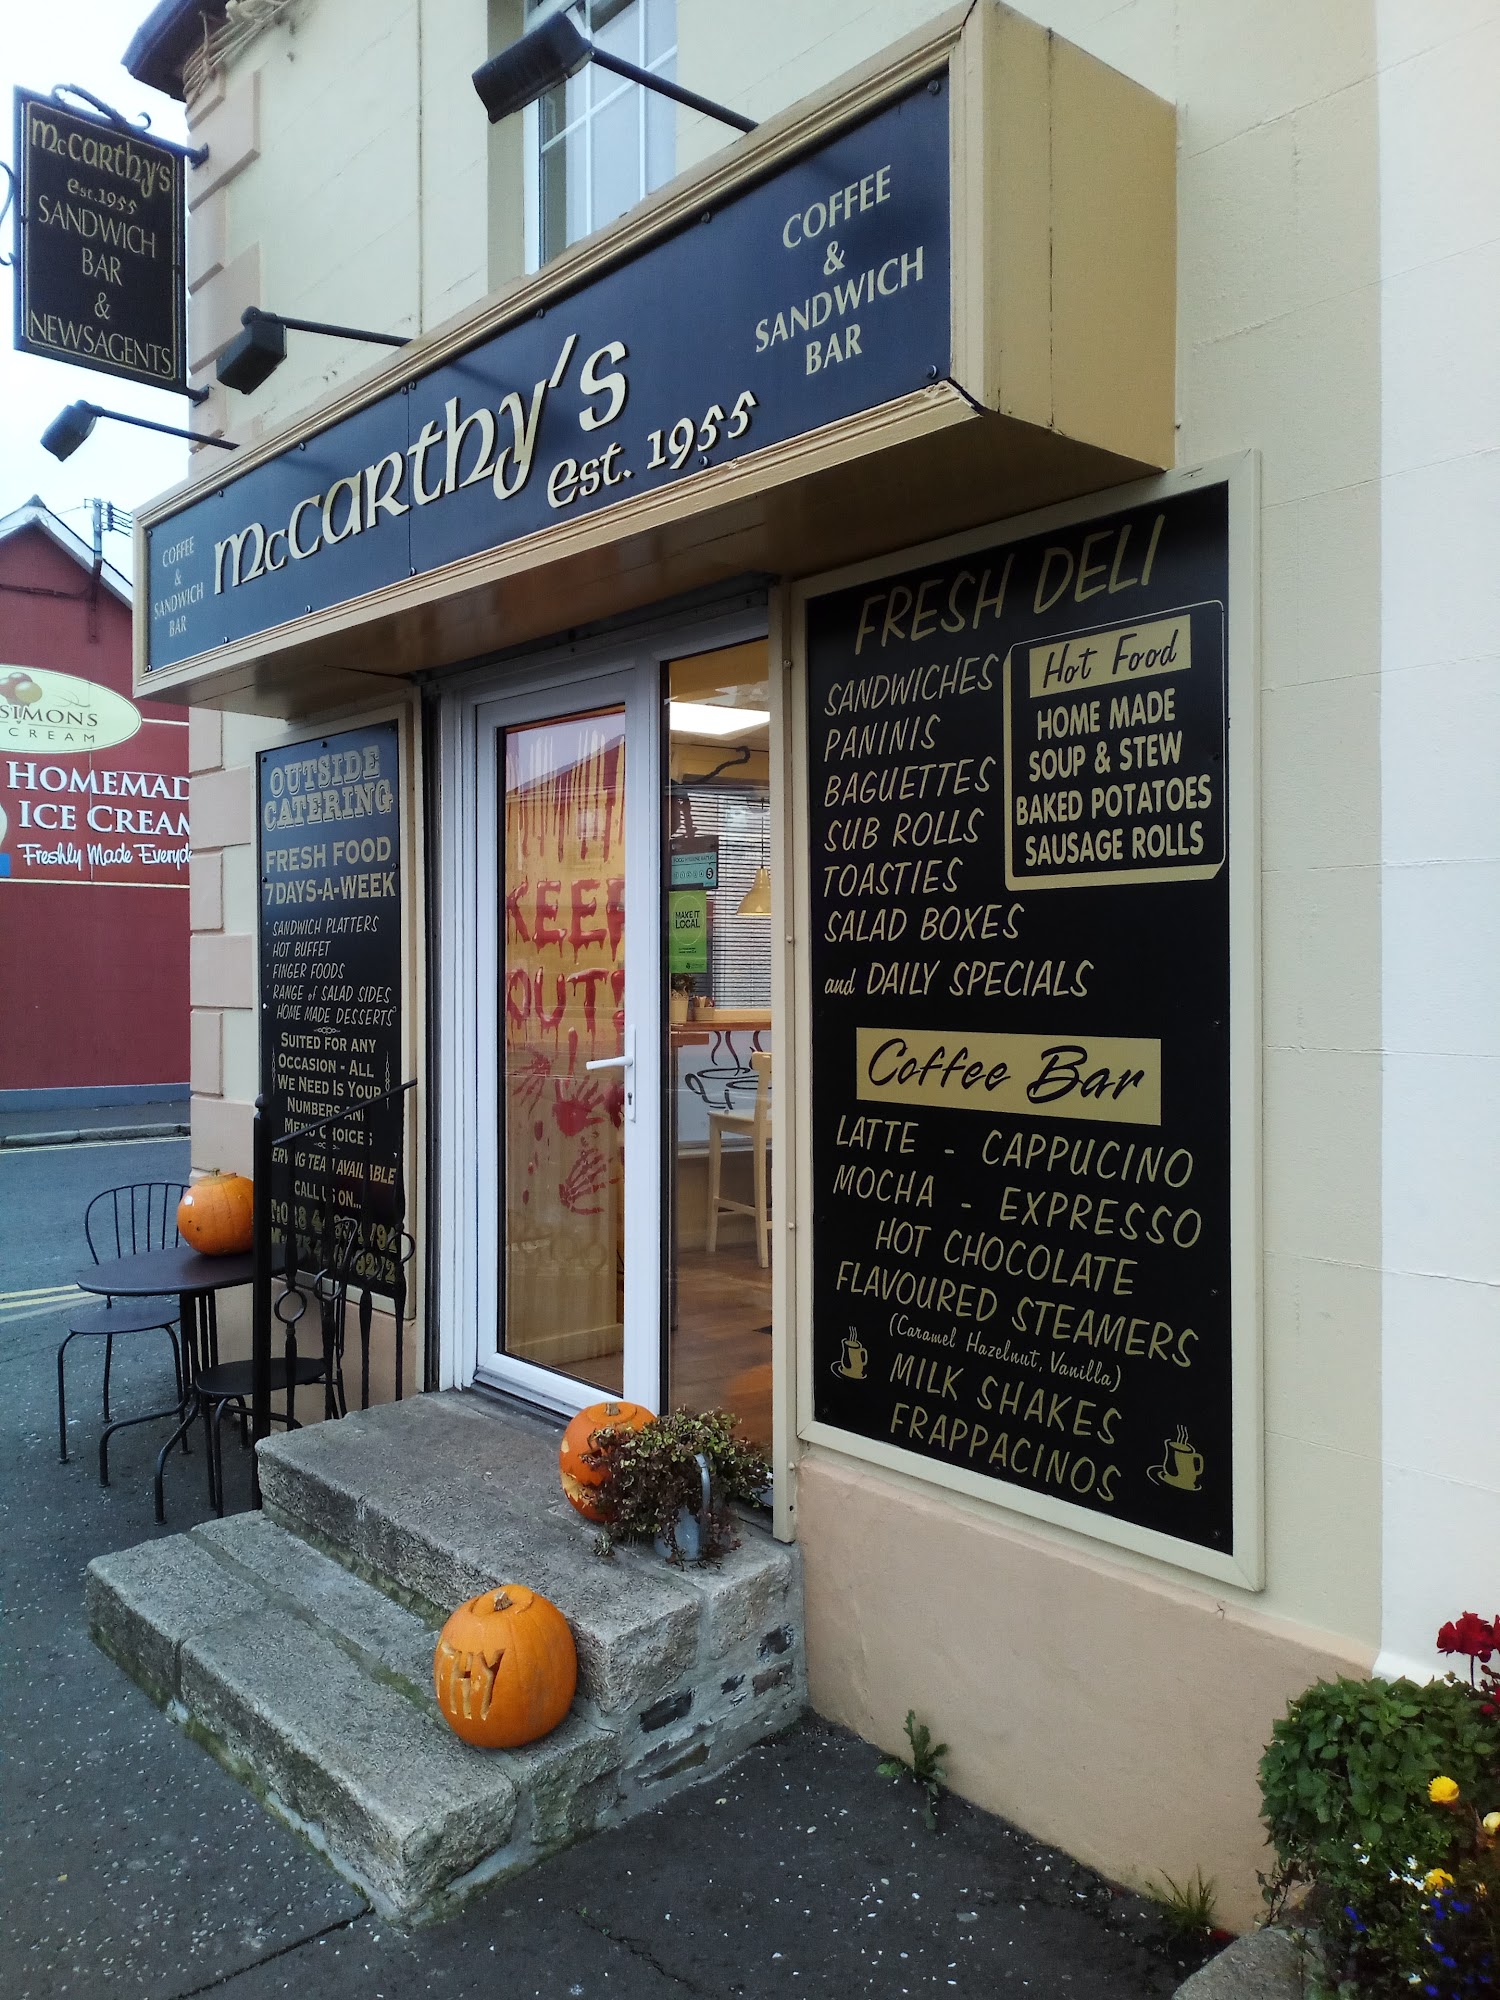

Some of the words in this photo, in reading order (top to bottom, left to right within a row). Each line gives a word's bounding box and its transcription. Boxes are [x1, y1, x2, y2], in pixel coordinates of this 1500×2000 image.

[38, 195, 156, 258] SANDWICH
[782, 164, 891, 249] COFFEE
[82, 248, 123, 286] BAR
[823, 240, 845, 276] &
[94, 292, 110, 320] &
[755, 245, 924, 353] SANDWICH
[30, 309, 171, 374] NEWSAGENTS
[806, 323, 863, 376] BAR
[547, 442, 633, 509] est.
[647, 390, 758, 470] 1955
[162, 536, 194, 568] COFFEE
[174, 568, 182, 586] &
[855, 553, 1015, 655] FRESH
[1033, 514, 1165, 615] DELI
[154, 582, 204, 620] SANDWICH
[169, 615, 187, 638] BAR
[1043, 648, 1098, 689] Hot
[1112, 629, 1179, 676] Food
[824, 653, 999, 717] SANDWICHES
[9, 727, 95, 743] CREAM
[1037, 701, 1100, 741] HOME
[1109, 687, 1176, 730] MADE
[824, 714, 941, 762] PANINIS
[1029, 744, 1086, 782] SOUP
[1094, 742, 1110, 775] &
[1120, 730, 1183, 770] STEW
[270, 745, 381, 798] OUTSIDE
[824, 756, 996, 807] BAGUETTES
[18, 800, 77, 831] ICE
[264, 779, 393, 831] CATERING
[1016, 791, 1082, 826] BAKED
[1092, 774, 1212, 820] POTATOES
[824, 820, 879, 852] SUB
[892, 808, 984, 848] ROLLS
[1025, 830, 1123, 867] SAUSAGE
[1132, 821, 1204, 859] ROLLS
[17, 842, 82, 871] Freshly
[87, 843, 133, 866] Made
[265, 843, 326, 873] FRESH
[333, 836, 391, 867] FOOD
[824, 857, 963, 898] TOASTIES
[272, 918, 322, 936] SANDWICH
[326, 915, 380, 935] PLATTERS
[675, 911, 693, 919] MAKE
[694, 910, 700, 918] IT
[675, 919, 700, 929] LOCAL
[824, 907, 907, 943] SALAD
[920, 903, 1025, 941] BOXES
[272, 942, 291, 958] HOT
[294, 940, 331, 957] BUFFET
[272, 963, 307, 980] FINGER
[310, 963, 345, 980] FOODS
[272, 984, 304, 1001] RANGE
[307, 985, 318, 1001] of
[321, 985, 354, 1002] SALAD
[358, 986, 392, 1004] SIDES
[824, 971, 855, 996] and
[867, 960, 941, 996] DAILY
[949, 960, 1094, 998] SPECIALS
[276, 1003, 301, 1021] HOME
[304, 1005, 331, 1023] MADE
[336, 1005, 394, 1028] DESSERTS
[325, 1037, 347, 1052] FOR
[351, 1038, 376, 1053] ANY
[867, 1038, 1011, 1093] Coffee
[1027, 1045, 1145, 1104] Bar
[836, 1114, 919, 1153] LATTE
[982, 1130, 1194, 1189] CAPPUCINO
[294, 1180, 320, 1200] CALL
[833, 1165, 934, 1209] MOCHA
[999, 1187, 1202, 1250] EXPRESSO
[875, 1219, 931, 1258] HOT
[943, 1229, 1138, 1296] CHOCOLATE
[836, 1261, 998, 1323] FLAVOURED
[1012, 1297, 1199, 1368] STEAMERS
[889, 1313, 956, 1349] (Caramel
[966, 1333, 1043, 1373] Hazelnut,
[1051, 1355, 1121, 1392] Vanilla)
[889, 1352, 964, 1401] MILK
[976, 1375, 1122, 1446] SHAKES
[889, 1402, 1122, 1502] FRAPPACINOS
